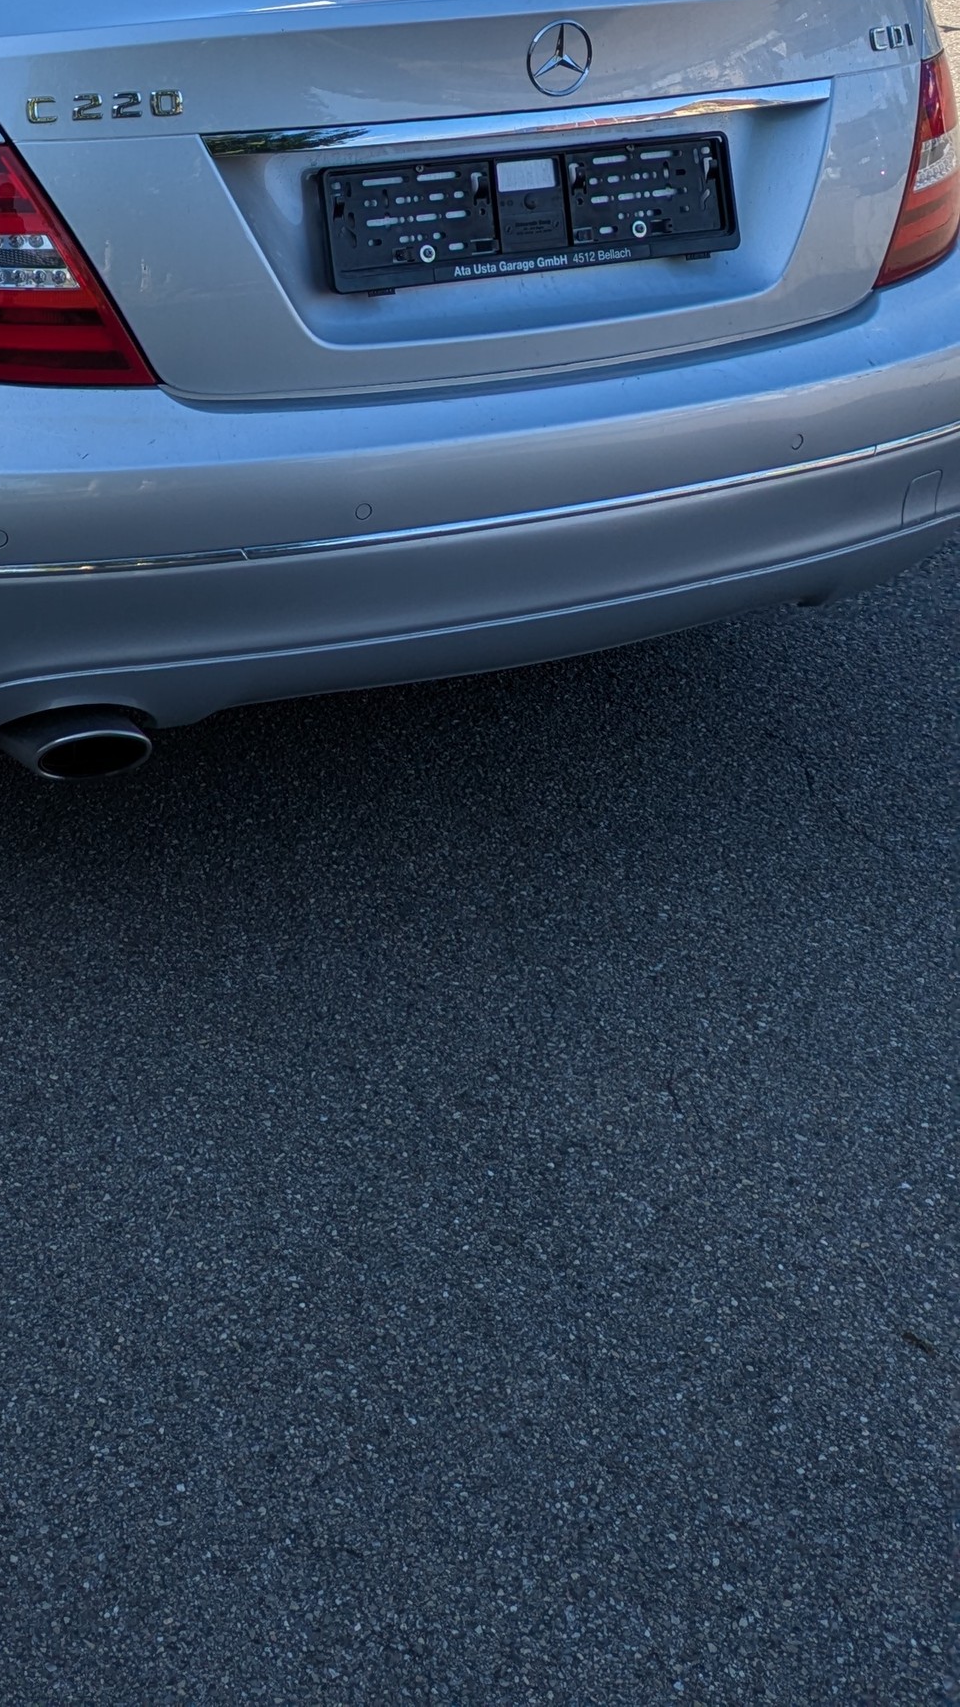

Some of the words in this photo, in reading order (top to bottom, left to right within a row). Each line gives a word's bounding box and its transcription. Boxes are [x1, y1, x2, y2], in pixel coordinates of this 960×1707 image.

[868, 23, 914, 52] CDI
[26, 95, 58, 124] C
[72, 89, 184, 121] 220
[453, 265, 472, 278] Ata
[473, 263, 497, 276] Usta
[499, 259, 535, 273] Garage
[537, 254, 568, 268] GmbH
[572, 251, 596, 263] 4512
[598, 247, 632, 261] Bellach
